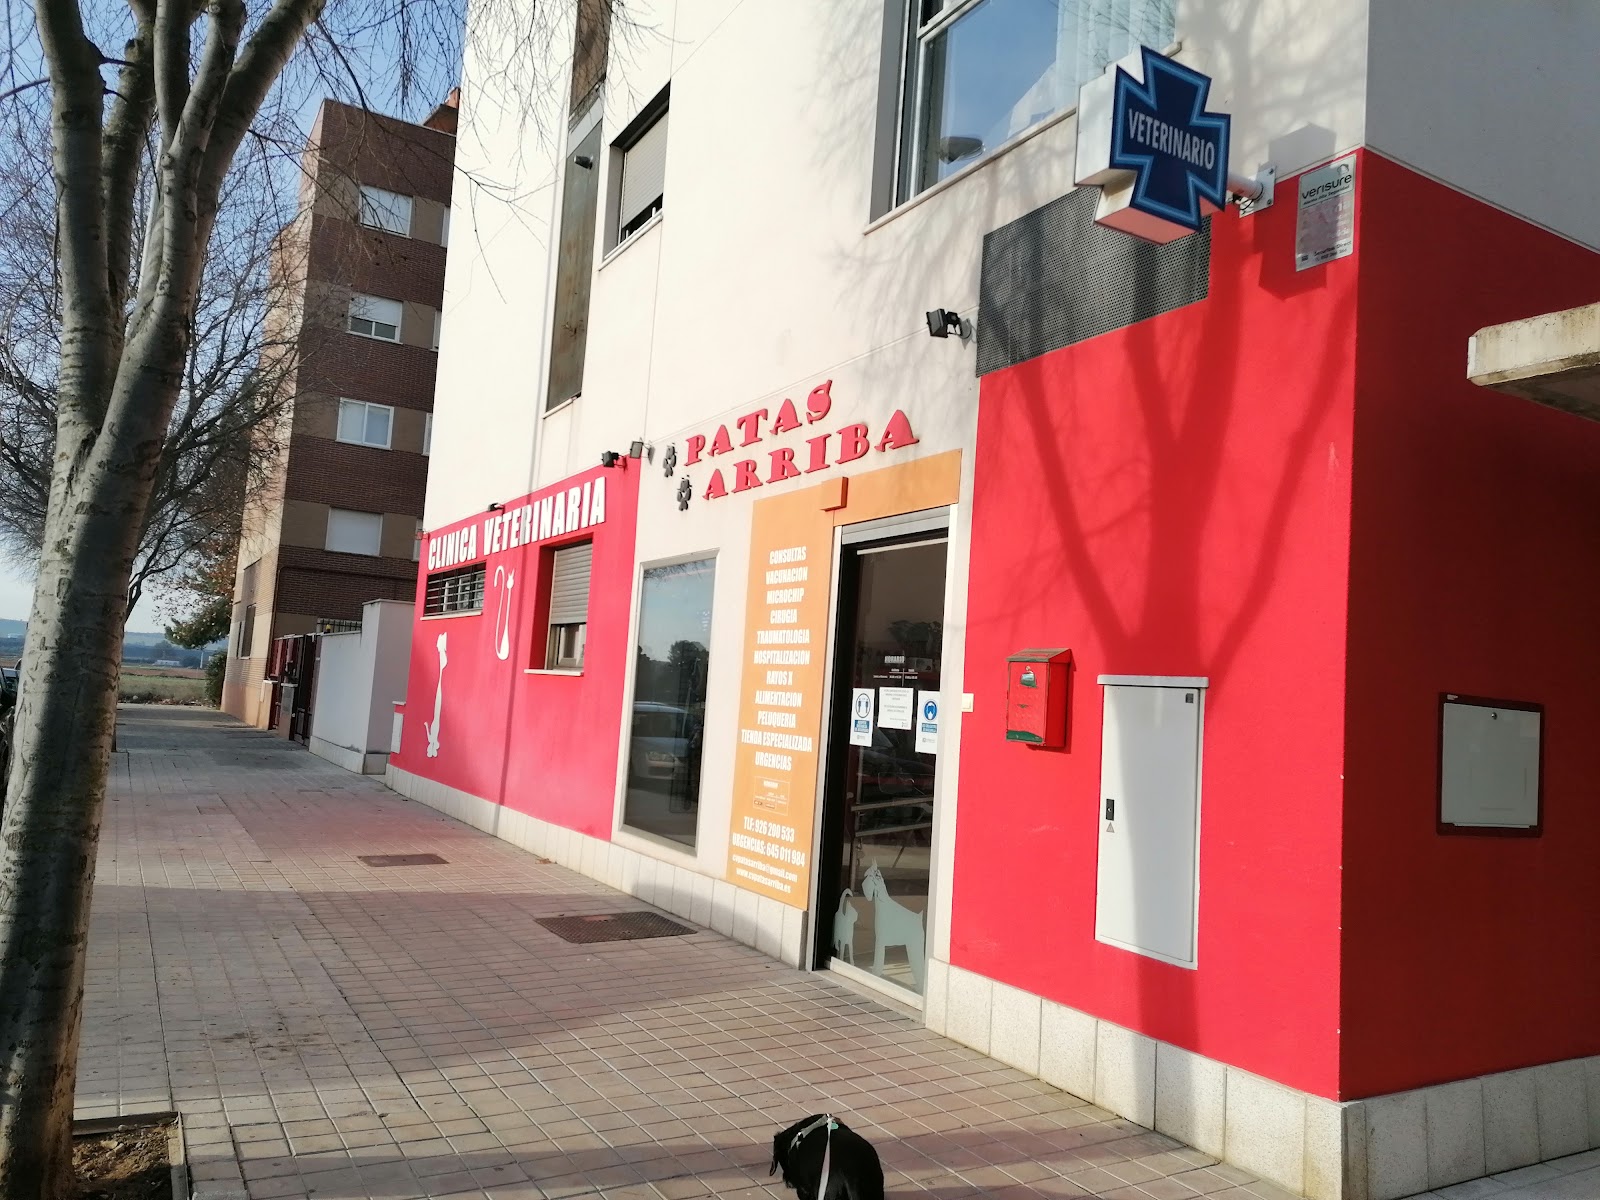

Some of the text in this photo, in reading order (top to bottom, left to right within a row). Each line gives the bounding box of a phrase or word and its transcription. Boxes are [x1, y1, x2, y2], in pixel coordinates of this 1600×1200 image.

[1128, 108, 1215, 170] VETERINARIO
[1301, 174, 1352, 200] verisure
[684, 379, 833, 467] PATAS
[702, 409, 920, 501] ARRIBA
[427, 476, 606, 571] CLINICA VETERINARIA
[769, 545, 807, 565] CONSULTAS
[765, 566, 808, 585] VACUNACION
[766, 587, 805, 605] MICROCHIP
[770, 609, 798, 624] CIRUGIA
[757, 629, 810, 645] TRAUMATOLOGIA
[753, 649, 811, 665] HOSPITALIZACION
[766, 670, 793, 686] RAYOS X
[755, 690, 803, 708] ALIMENTACION
[757, 710, 796, 728] PELUQUERIA
[741, 729, 813, 753] TIENDA ESPECIALIZADA
[755, 751, 792, 771] URGENCIAS
[755, 819, 767, 835] 926
[767, 822, 781, 839] 200
[781, 825, 795, 843] 533
[732, 832, 806, 867] URGENCIAS: 645 011 984
